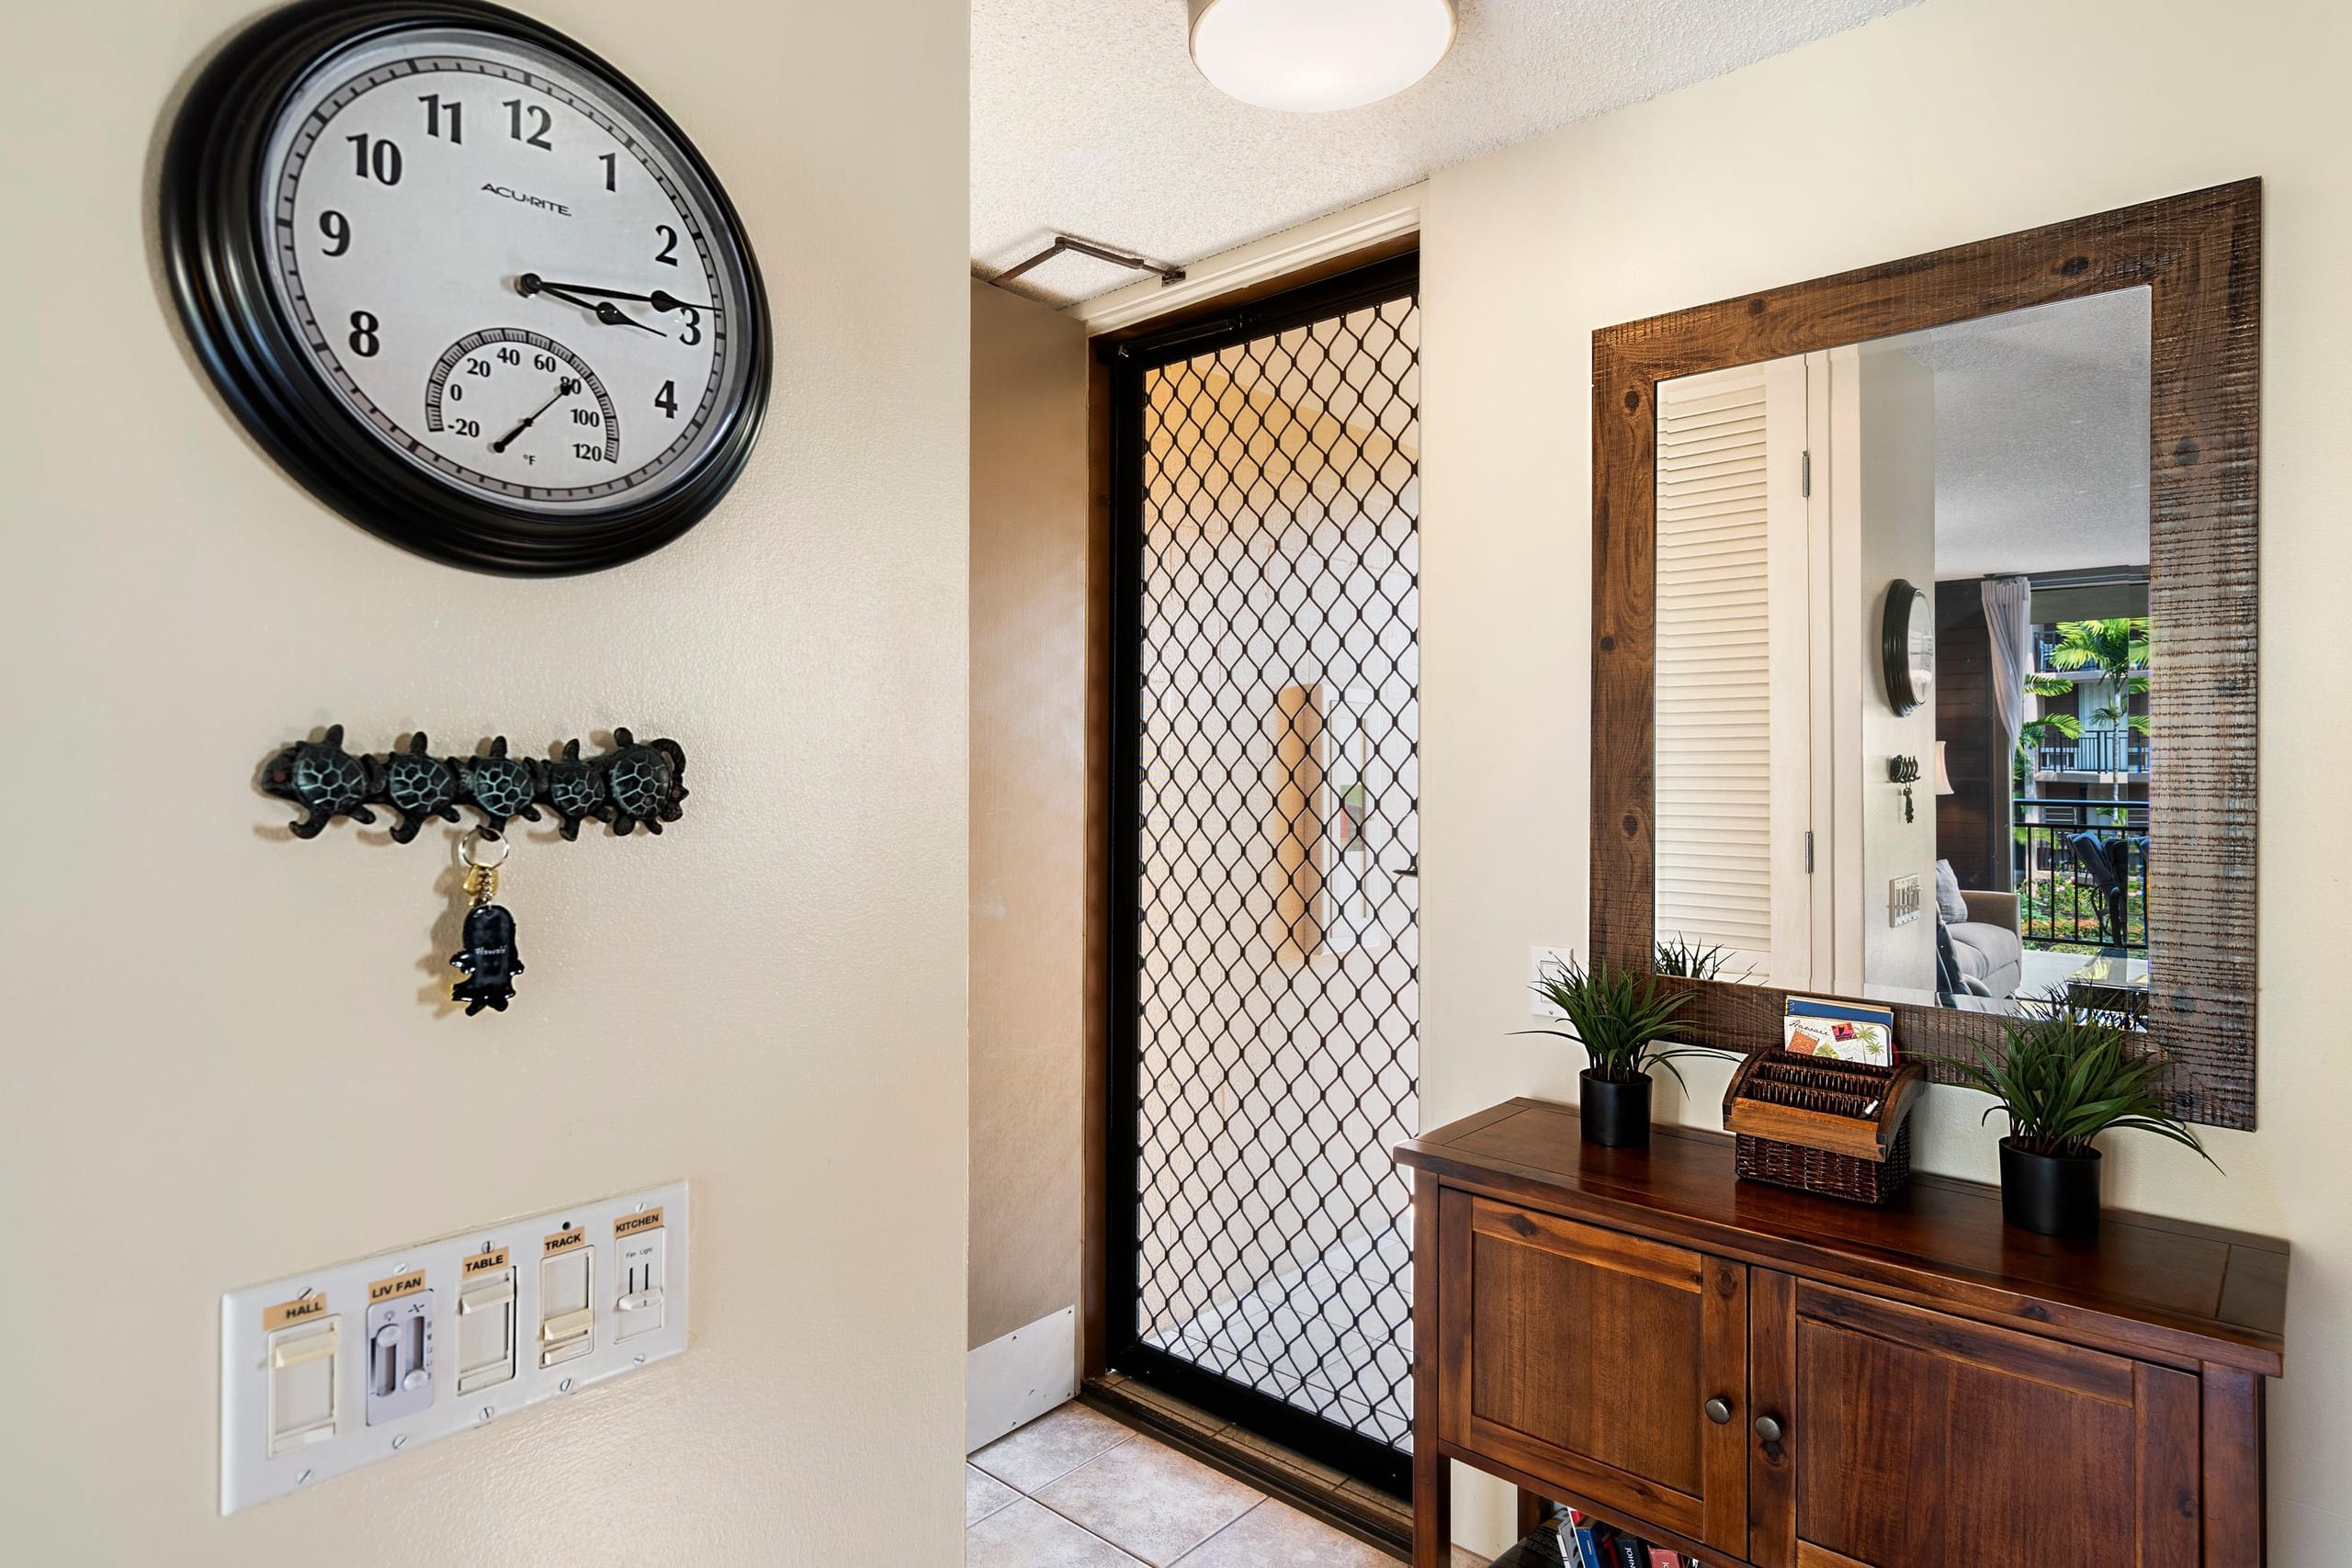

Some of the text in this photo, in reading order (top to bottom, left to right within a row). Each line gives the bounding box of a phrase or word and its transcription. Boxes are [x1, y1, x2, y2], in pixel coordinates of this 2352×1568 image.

[418, 94, 461, 145] 11
[503, 98, 552, 151] 12
[345, 132, 402, 186] 10
[598, 152, 616, 193] 1
[319, 210, 351, 257] 9
[654, 224, 678, 266] 2
[348, 310, 380, 357] 8
[679, 307, 701, 345] 3
[496, 346, 521, 366] 40
[534, 355, 557, 373] 60
[467, 357, 491, 378] 20
[449, 384, 462, 401] 0
[654, 379, 678, 419] 4
[571, 409, 600, 428] 100
[573, 443, 602, 462] 120
[615, 1213, 660, 1234] KITCHEN
[545, 1233, 582, 1252] TRACK
[465, 1254, 504, 1273] TABLE
[372, 1278, 422, 1299] LIV FAN
[286, 1302, 323, 1320] HALL
